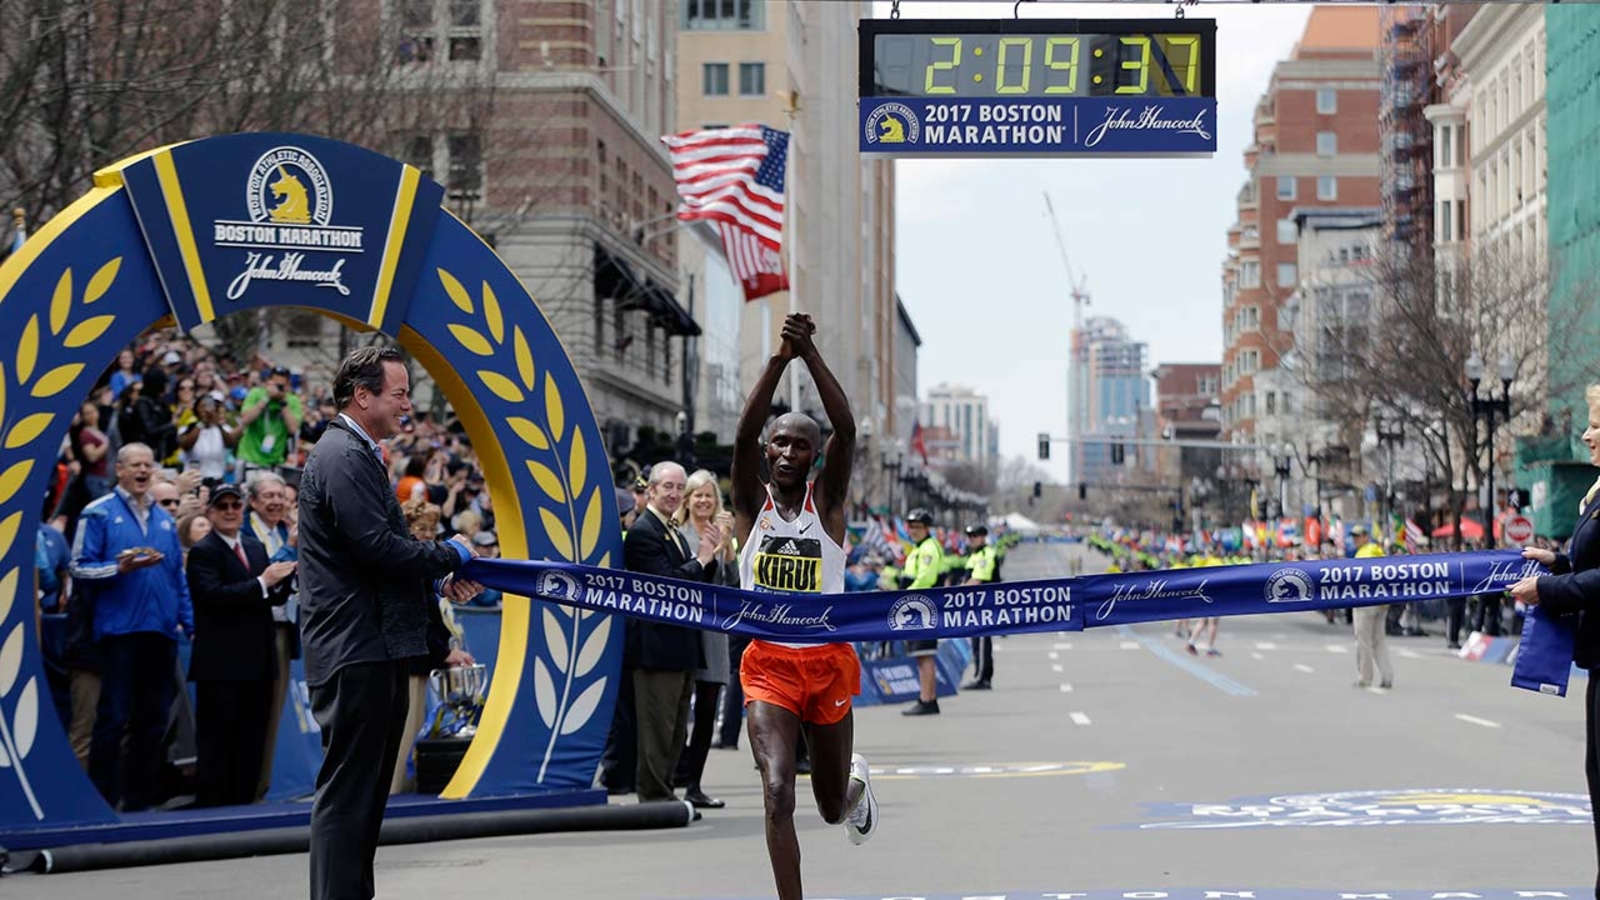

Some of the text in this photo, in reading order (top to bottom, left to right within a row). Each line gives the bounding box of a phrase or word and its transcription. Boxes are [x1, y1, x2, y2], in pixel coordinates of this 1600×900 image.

[924, 37, 1198, 94] 2:09:37
[925, 105, 1061, 122] 2017 BOSTON
[925, 126, 1062, 144] MARATHON
[214, 225, 362, 247] BOSTON MARATHON
[758, 555, 818, 591] KIRUI
[1320, 562, 1449, 583] 2017 BOSTON
[585, 574, 625, 590] 2017
[632, 579, 703, 605] BOSTON
[943, 586, 1071, 608] 2017 BOSTON
[1320, 581, 1450, 600] MARATHON
[585, 588, 704, 623] MARATHON
[943, 605, 1071, 628] MARATHON
